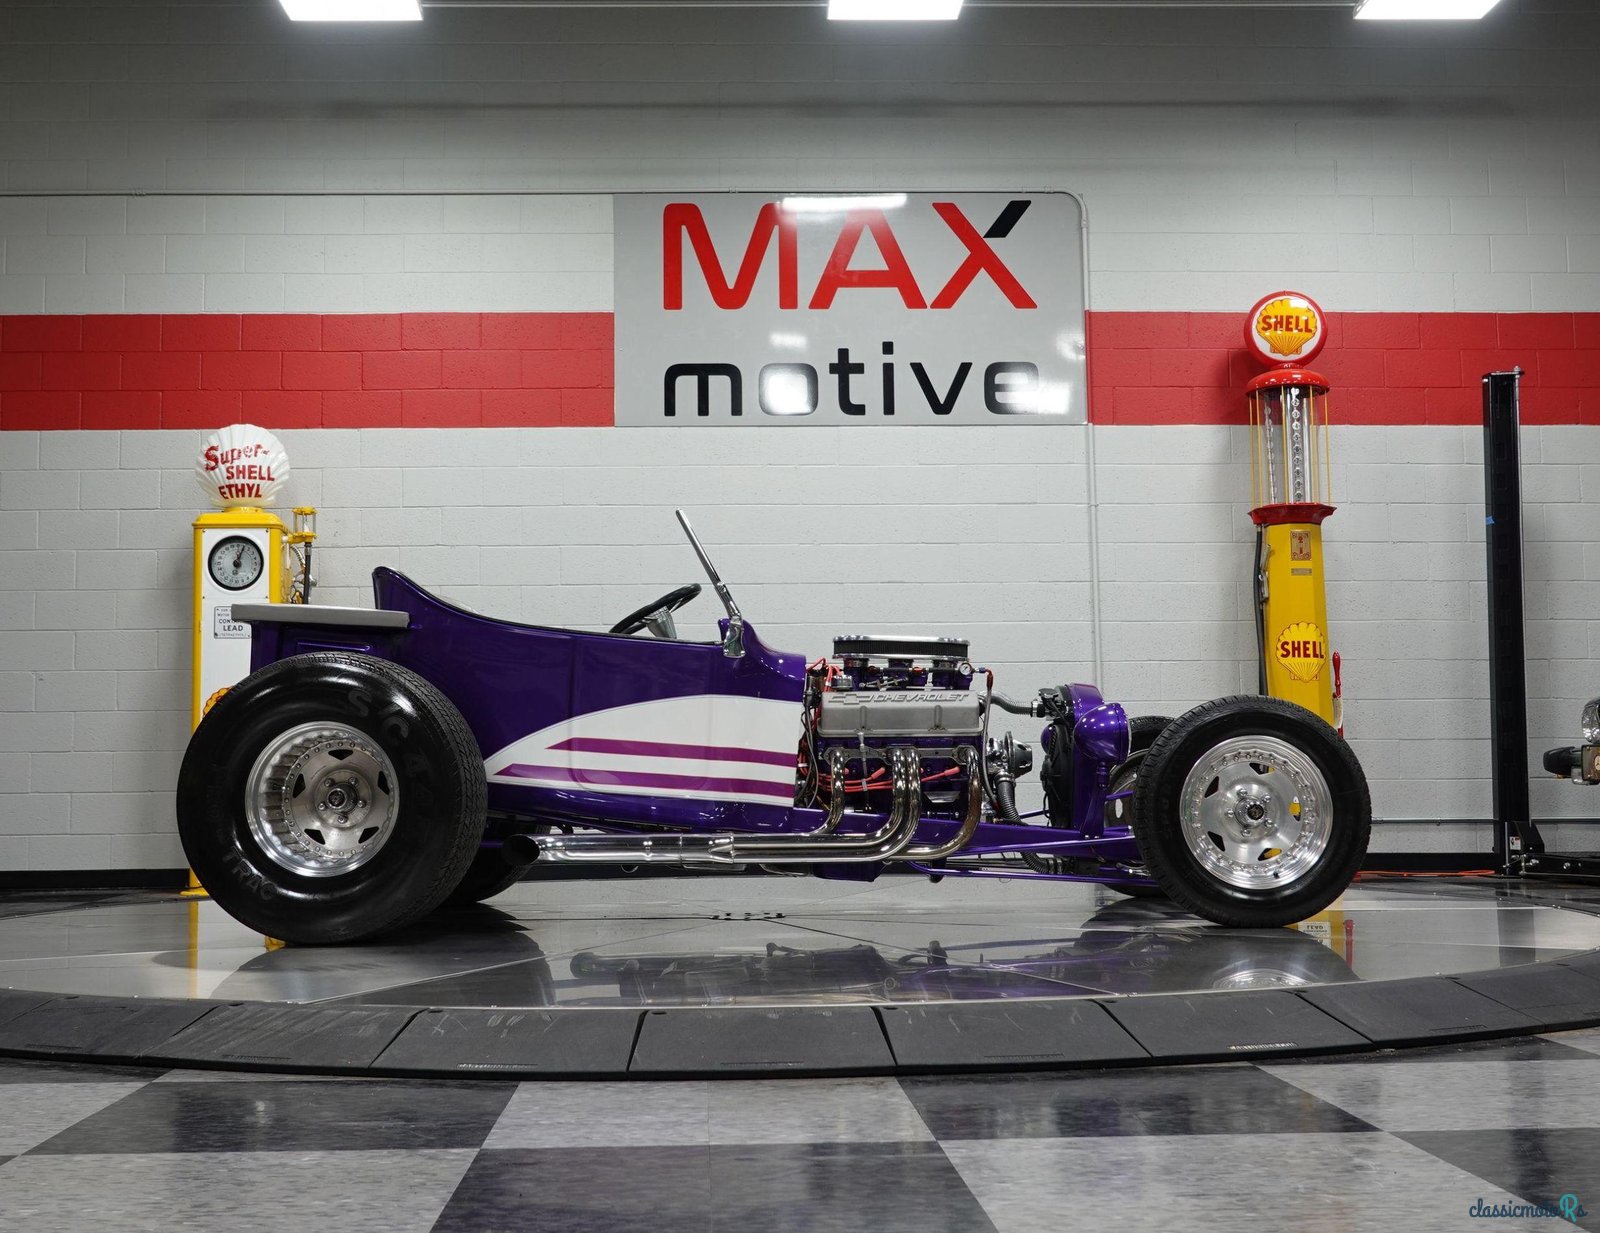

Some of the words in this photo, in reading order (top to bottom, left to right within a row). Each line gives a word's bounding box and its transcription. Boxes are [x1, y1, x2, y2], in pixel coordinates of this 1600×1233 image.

[663, 200, 1038, 310] MAX
[1261, 314, 1313, 333] SHELL
[664, 341, 1040, 417] motive
[226, 465, 275, 481] SHELL
[218, 483, 262, 500] ETHYL
[1280, 640, 1324, 659] SHELL
[873, 692, 970, 703] CHEVROLET
